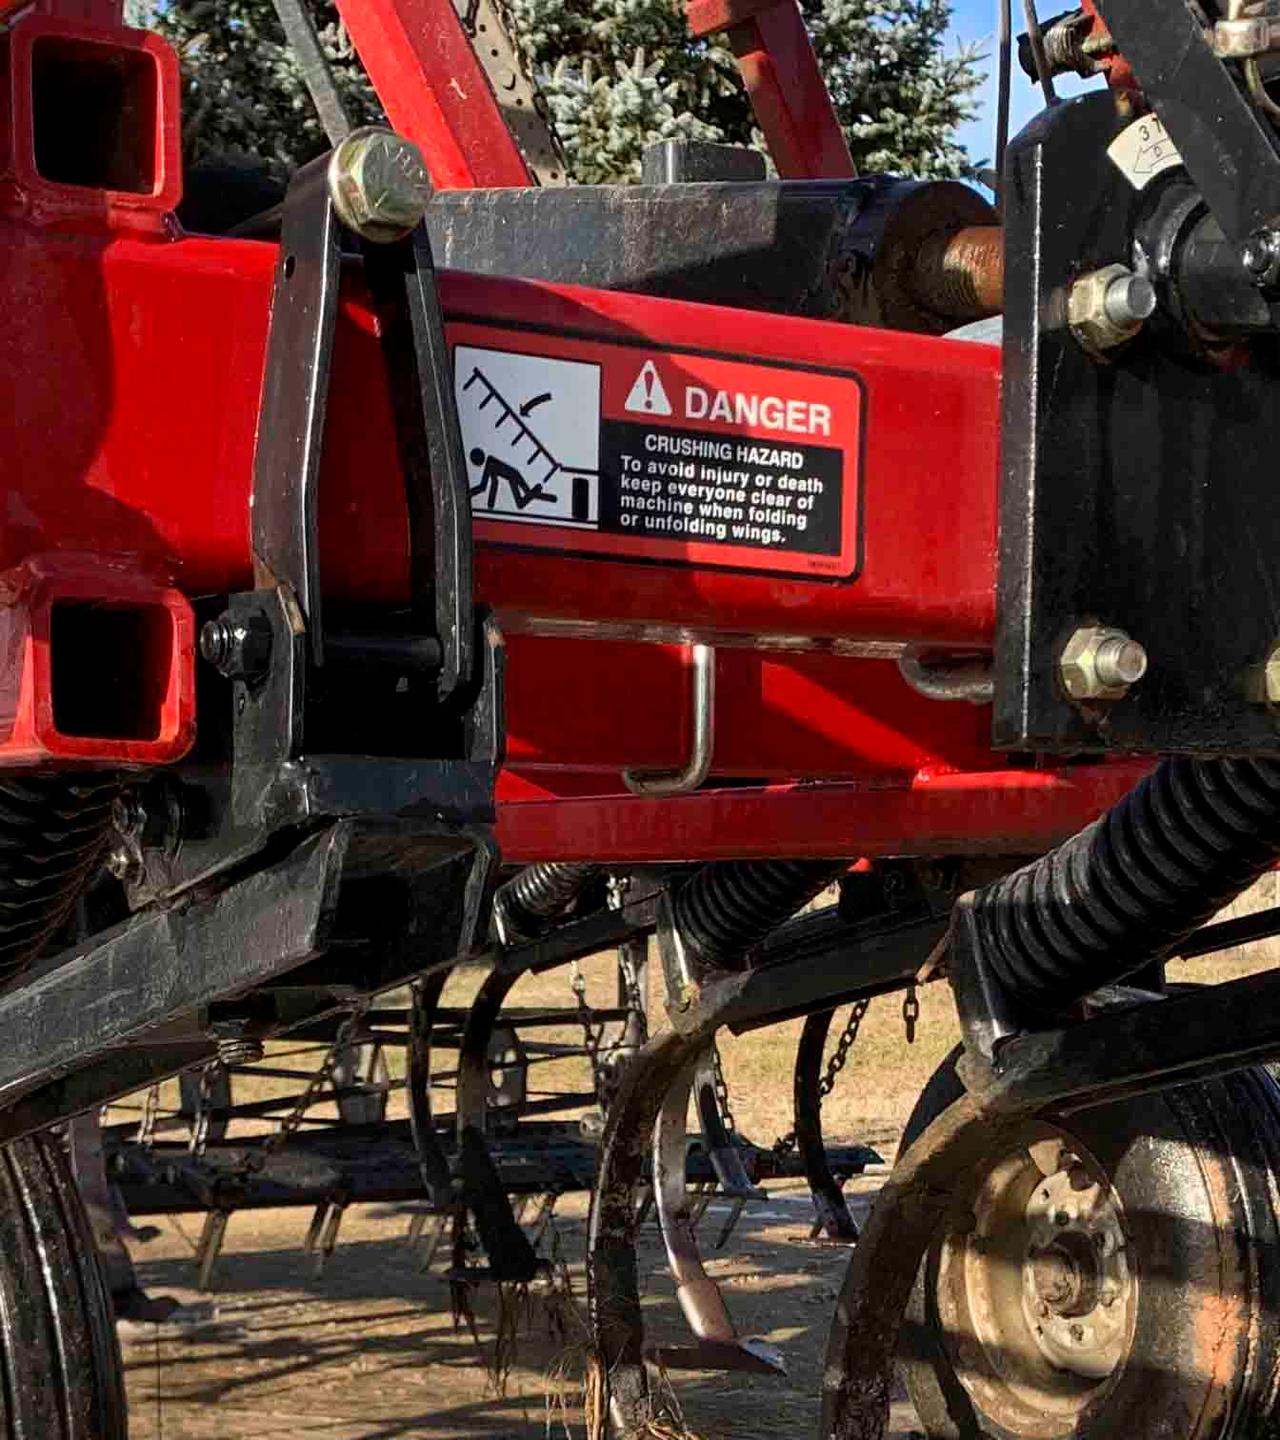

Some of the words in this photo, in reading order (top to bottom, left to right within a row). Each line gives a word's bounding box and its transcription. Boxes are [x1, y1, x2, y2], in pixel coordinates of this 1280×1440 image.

[685, 386, 832, 436] DANGER
[645, 434, 733, 461] CRUSHING
[736, 445, 804, 469] HAZARD
[620, 455, 641, 472] To
[647, 461, 696, 479] avoid
[700, 465, 750, 487] injury
[755, 473, 773, 488] or
[777, 474, 824, 494] death
[621, 474, 662, 495] keep
[668, 481, 746, 502] everyone
[751, 490, 792, 508] clear
[797, 495, 815, 511] of
[620, 513, 639, 527] or
[644, 515, 727, 540] unfolding
[731, 523, 787, 545] wings.
[621, 494, 694, 515] machine
[699, 502, 744, 521] when
[748, 507, 808, 530] folding
